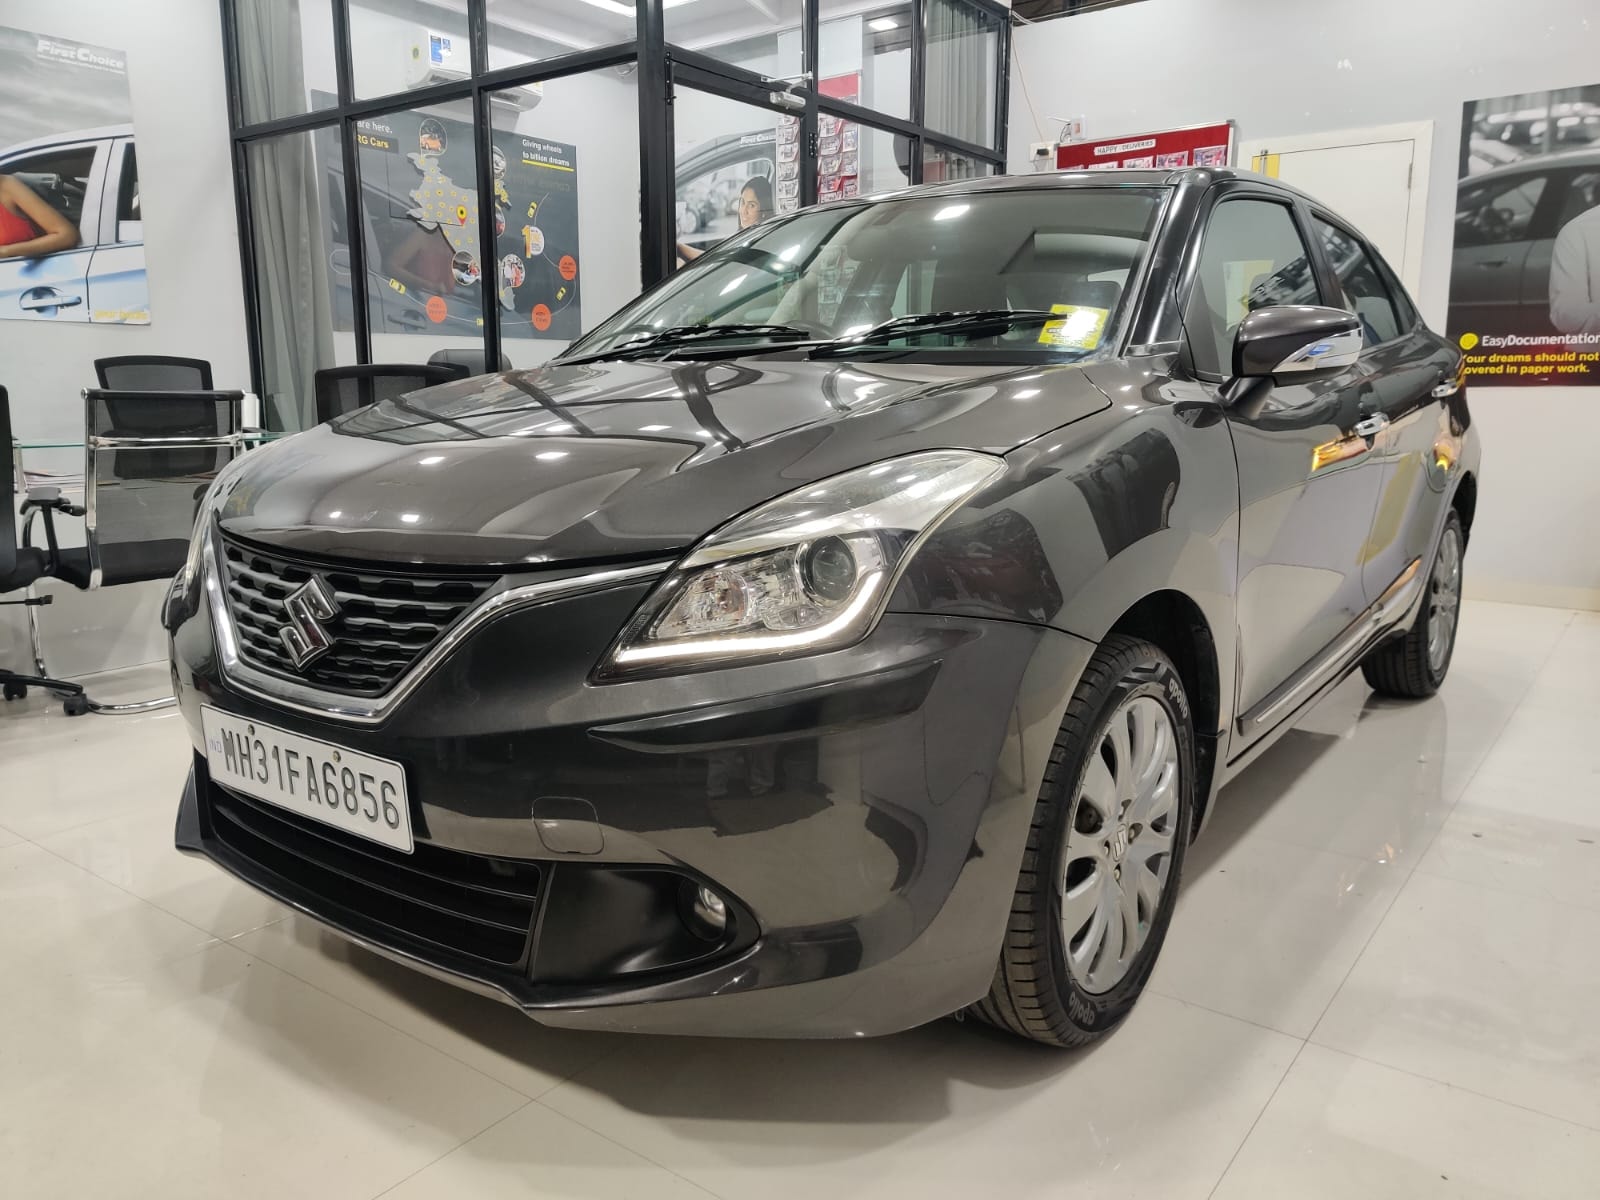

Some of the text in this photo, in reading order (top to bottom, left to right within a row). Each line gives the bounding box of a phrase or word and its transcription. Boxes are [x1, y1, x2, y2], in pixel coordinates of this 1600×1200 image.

[370, 136, 389, 149] Cars
[522, 139, 563, 154] Giving wheels
[1097, 140, 1154, 153] HAPPY DELIVERIES
[522, 151, 530, 159] to
[548, 155, 570, 167] dreams
[1489, 353, 1531, 363] dreams
[1534, 352, 1576, 362] should
[1579, 352, 1599, 361] not
[1464, 363, 1590, 375] overed in paper work.
[1168, 677, 1188, 719] apollo
[221, 727, 400, 830] MH31FA6856
[1069, 991, 1095, 1025] apollo
